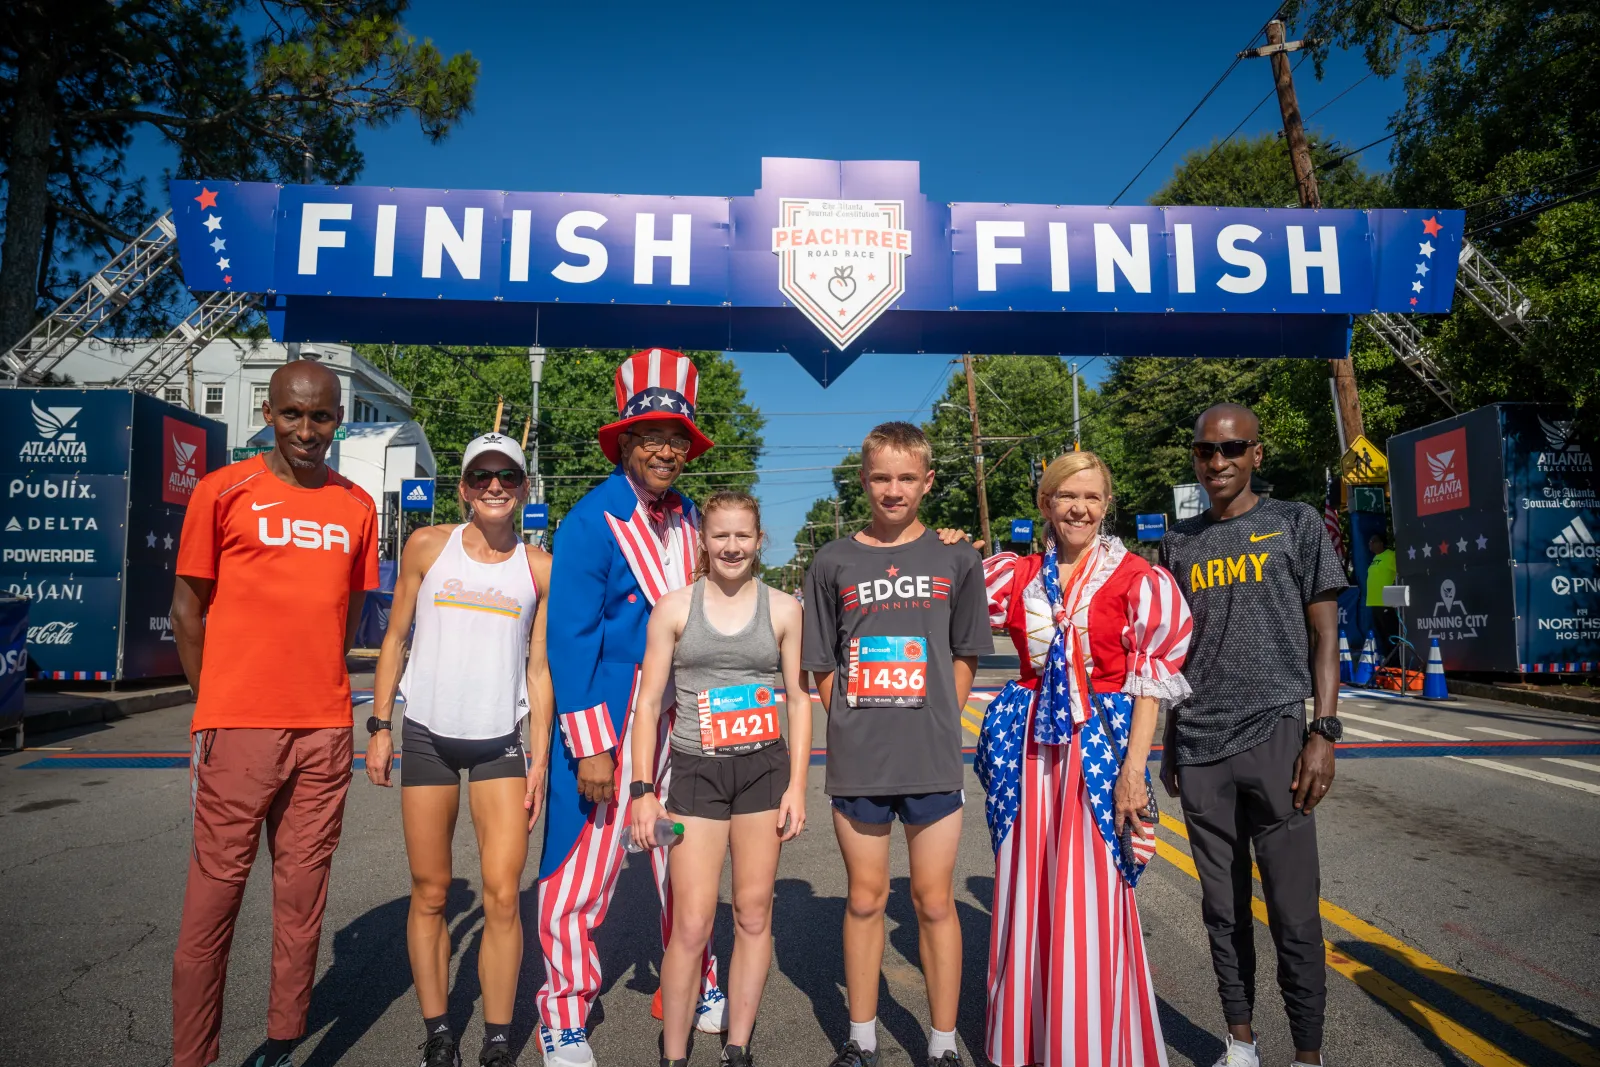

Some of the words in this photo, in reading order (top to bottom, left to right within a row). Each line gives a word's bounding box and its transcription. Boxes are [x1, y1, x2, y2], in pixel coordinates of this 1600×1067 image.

[298, 202, 692, 285] FINISH
[776, 228, 908, 251] PEACHTREE
[807, 250, 838, 258] ROAD
[845, 251, 875, 259] RACE
[975, 220, 1342, 294] FINISH
[19, 441, 88, 456] ATLANTA
[1537, 452, 1593, 466] ATLANTA
[1424, 479, 1462, 499] ATLANTA
[1543, 487, 1561, 498] The
[1562, 487, 1596, 498] Atlanta
[28, 517, 98, 531] DELTA
[258, 517, 350, 554] USA
[3, 549, 95, 563] POWERADE
[1191, 552, 1269, 593] ARMY
[8, 580, 84, 604] DASANI
[858, 576, 931, 605] EDGE
[1571, 577, 1600, 593] PN
[861, 601, 931, 615] RUNNING
[150, 616, 173, 630] RUN
[1417, 615, 1463, 630] RUNNING
[1465, 614, 1488, 628] CITY
[848, 638, 860, 677] MILE
[862, 668, 925, 690] 1436
[698, 690, 711, 729] MILE
[721, 696, 744, 704] Microsoft
[717, 712, 774, 739] 1421
